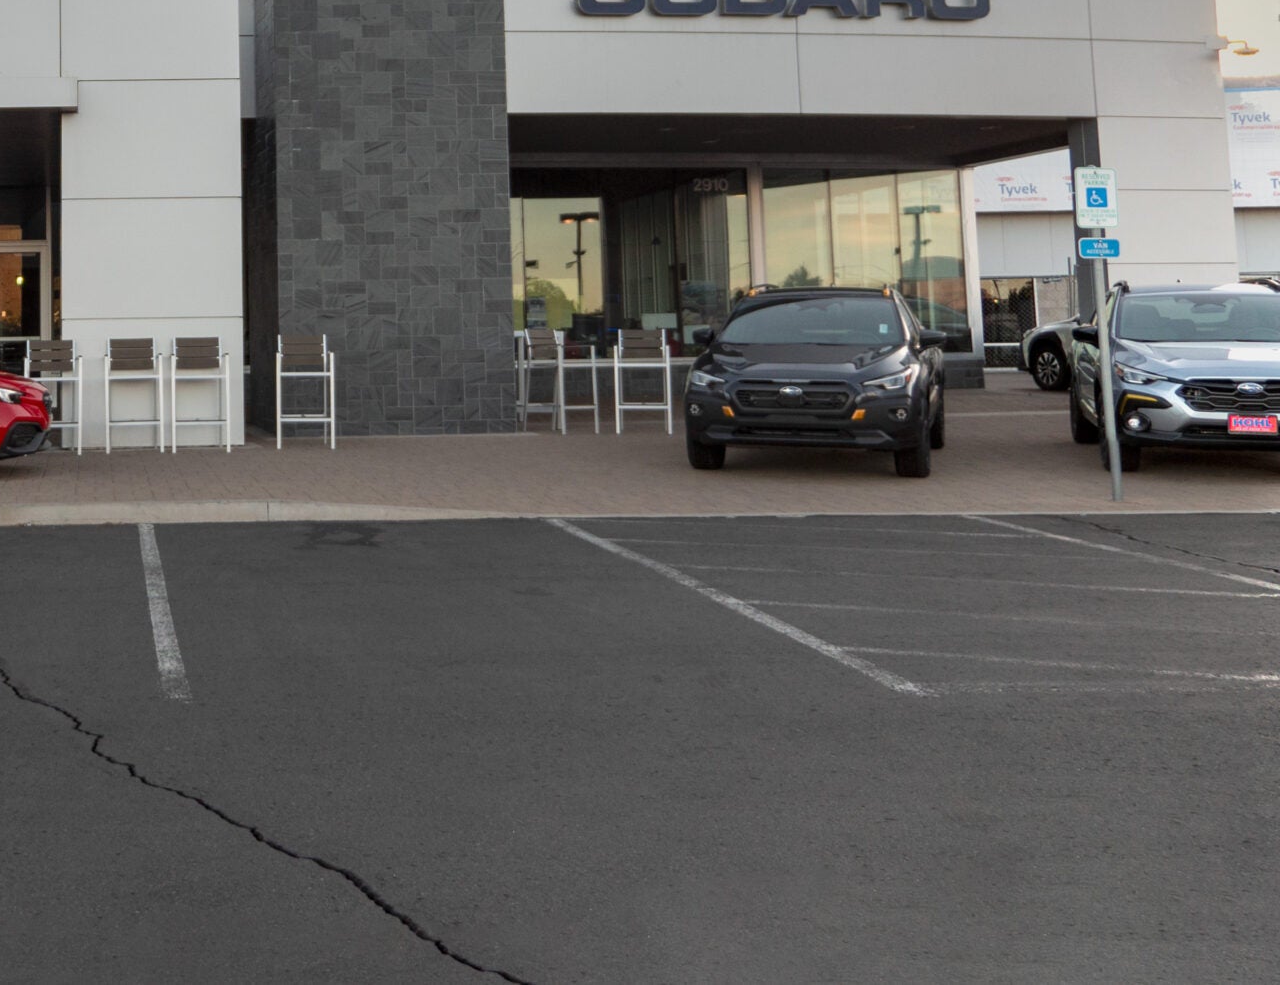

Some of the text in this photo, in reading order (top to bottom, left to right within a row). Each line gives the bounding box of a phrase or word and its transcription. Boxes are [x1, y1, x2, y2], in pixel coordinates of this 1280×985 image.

[1231, 111, 1271, 125] Tyvek
[692, 177, 729, 192] 2910
[998, 182, 1038, 197] Tyvek
[1092, 241, 1109, 249] VAN
[1232, 417, 1272, 427] HOHL
